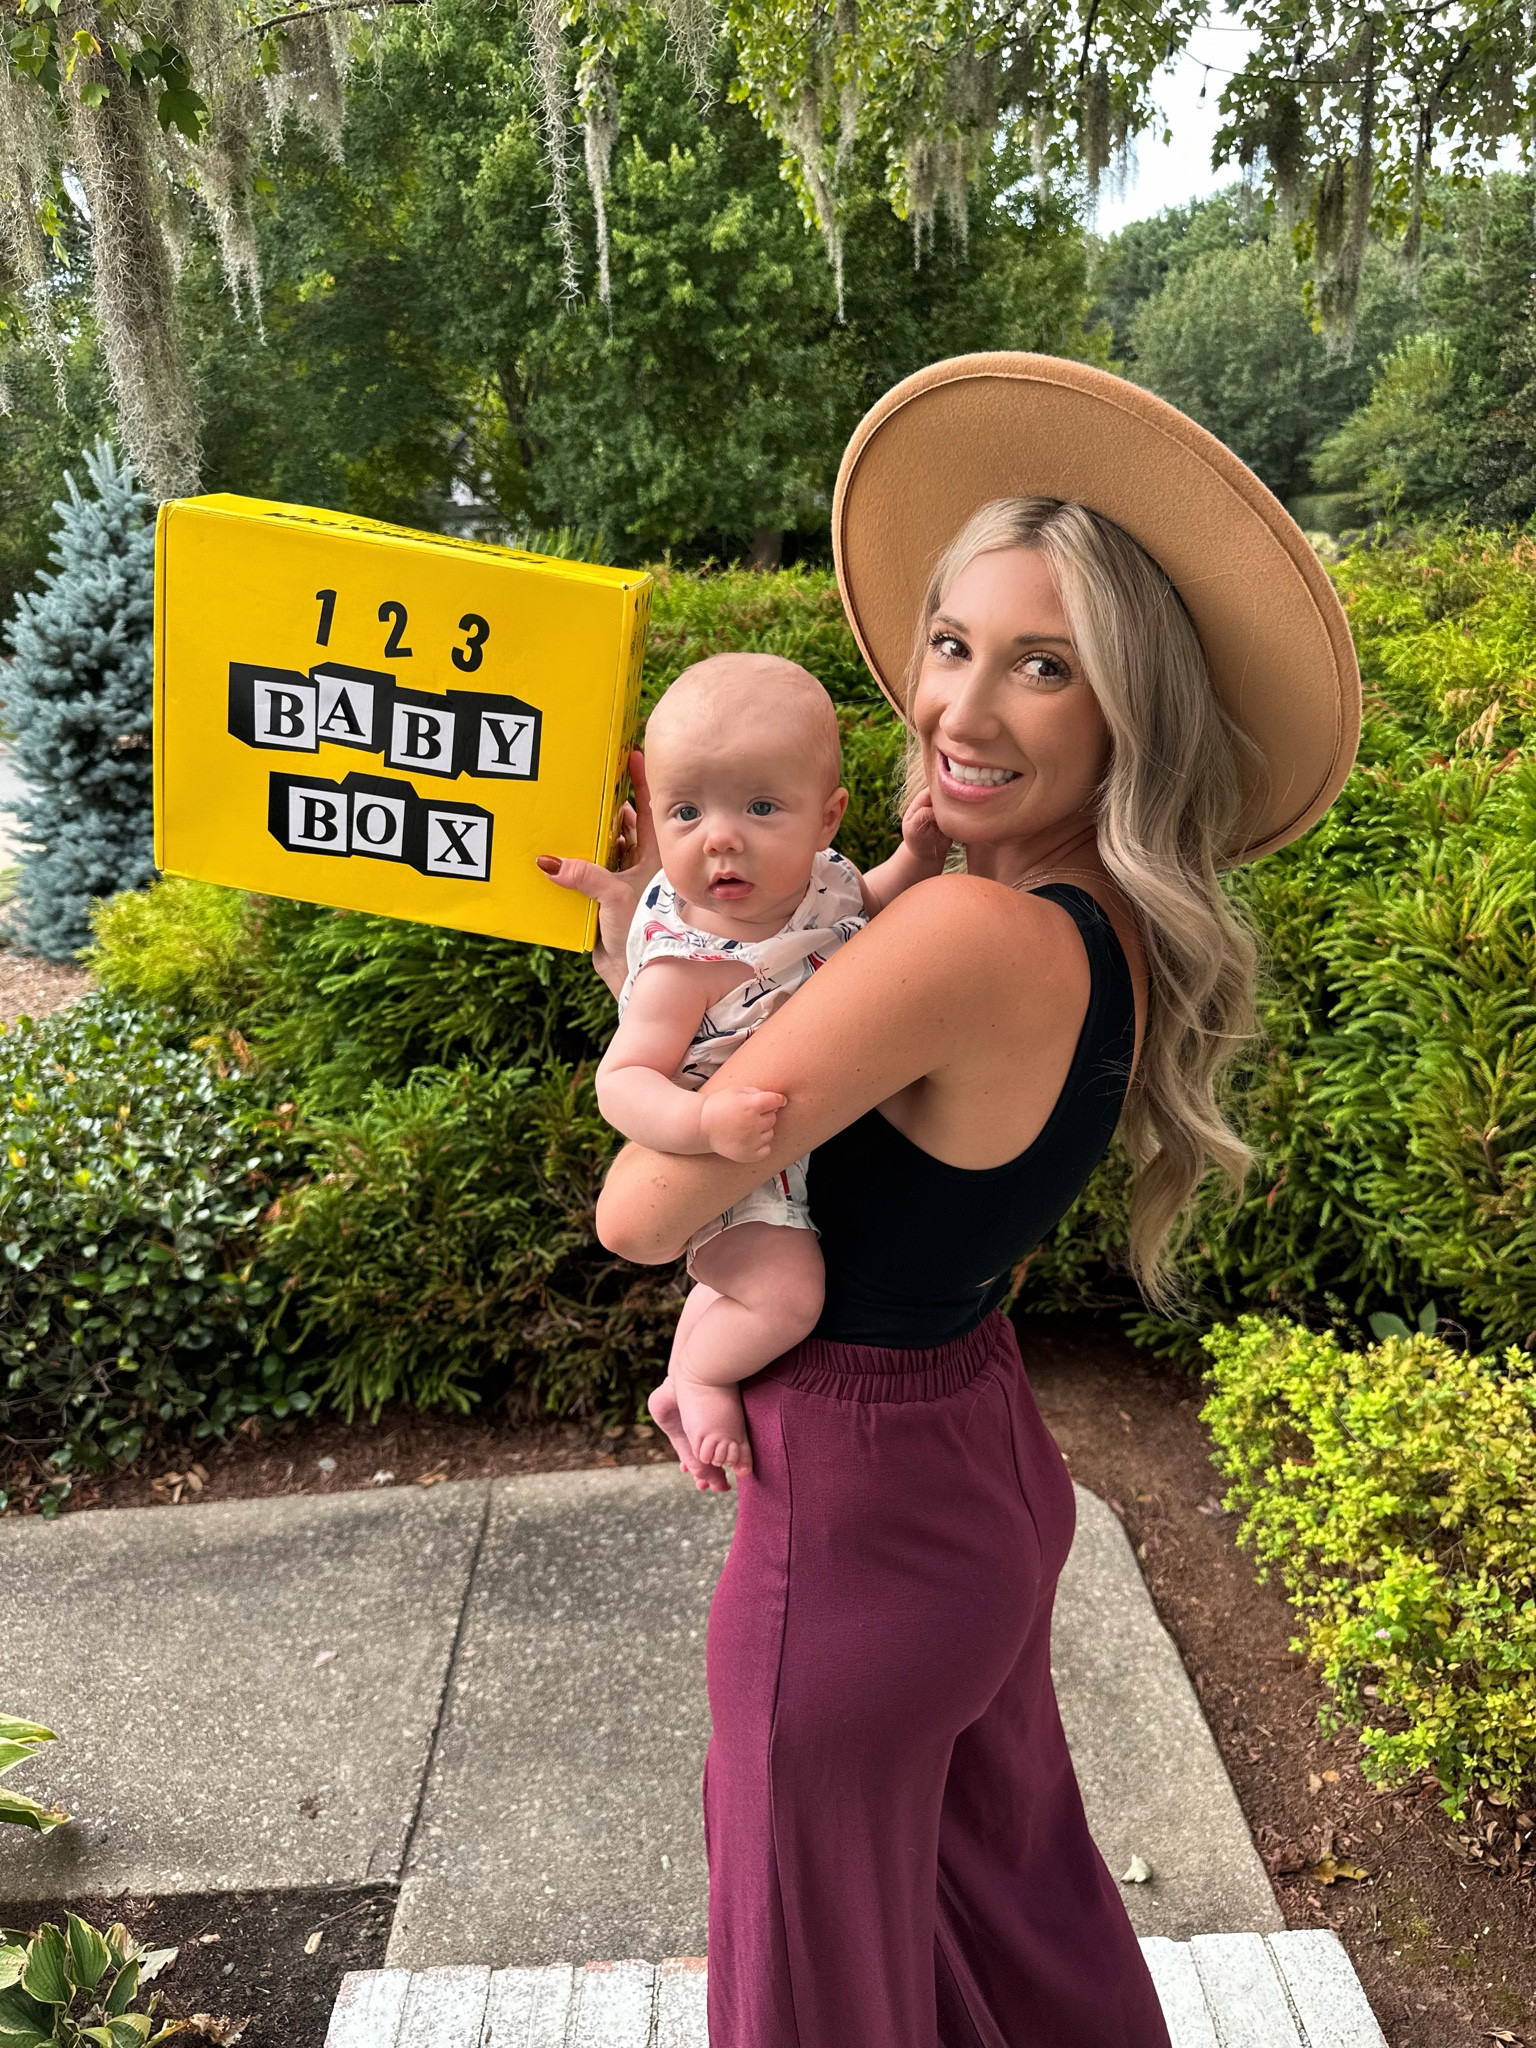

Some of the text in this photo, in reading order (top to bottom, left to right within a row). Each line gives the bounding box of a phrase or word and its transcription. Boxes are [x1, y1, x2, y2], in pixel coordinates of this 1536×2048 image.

[315, 589, 490, 673] 1 2 3
[263, 685, 530, 768] BABY
[296, 794, 480, 868] BOX
